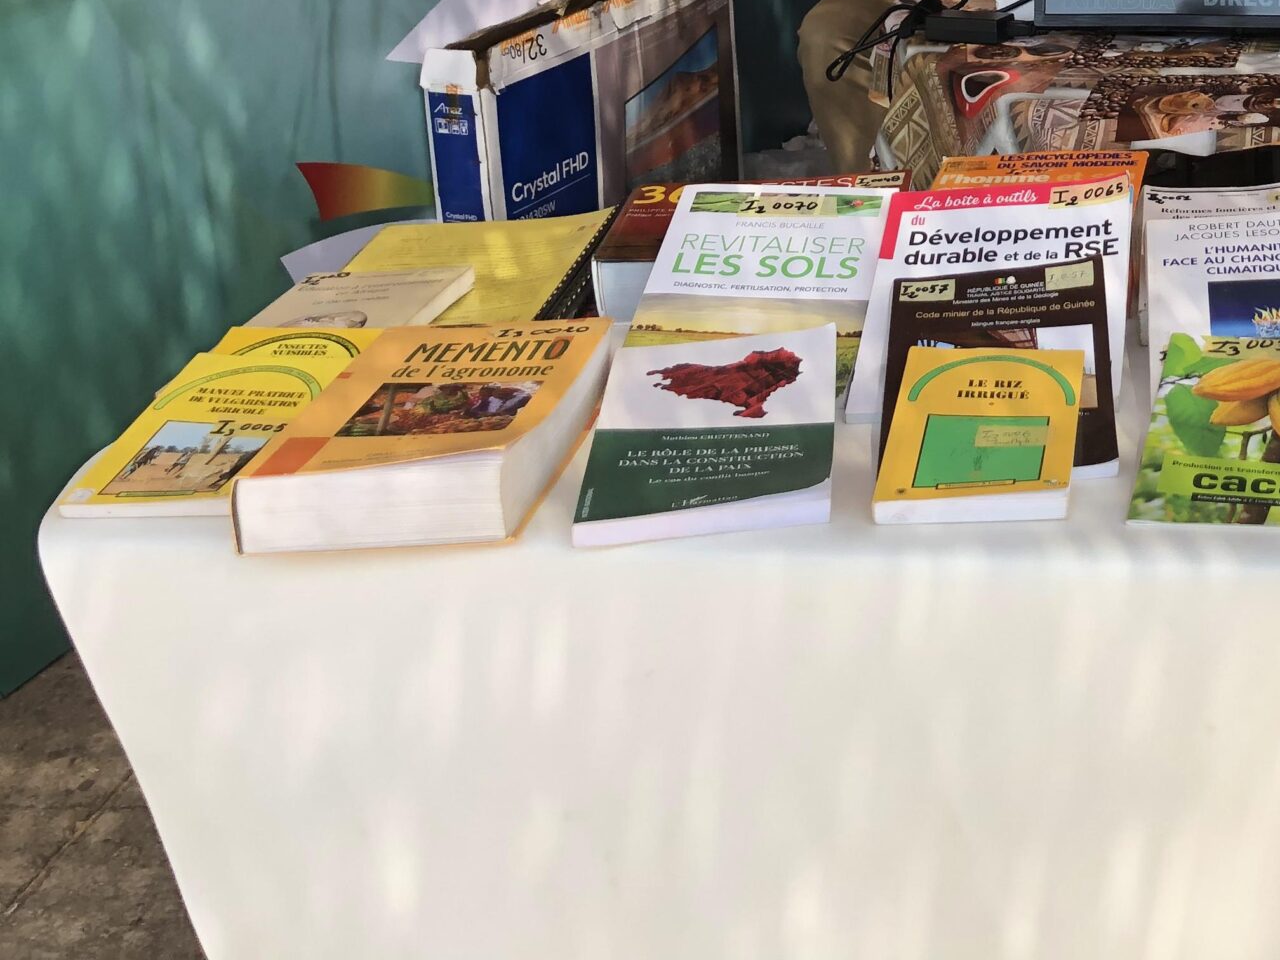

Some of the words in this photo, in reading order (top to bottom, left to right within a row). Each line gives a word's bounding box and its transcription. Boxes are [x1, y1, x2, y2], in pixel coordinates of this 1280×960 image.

[1000, 154, 1026, 162] LES
[1020, 161, 1068, 169] SAVOIR
[1072, 159, 1139, 167] MODERNE
[512, 163, 560, 202] Crystal
[562, 151, 589, 179] FHD
[914, 196, 942, 210] La
[945, 193, 980, 207] boîte
[984, 193, 993, 204] à
[996, 188, 1039, 204] outils
[735, 221, 777, 229] FRANCIS
[779, 221, 826, 230] BUCAILLE
[910, 213, 926, 226] du
[1188, 221, 1240, 231] ROBERT
[908, 219, 1113, 248] Développement
[1175, 230, 1240, 241] JACQUES
[680, 233, 866, 255] REVITALISER
[904, 245, 998, 266] durable
[1004, 251, 1019, 262] et
[1024, 249, 1041, 261] de
[1045, 249, 1058, 260] la
[1064, 238, 1119, 259] RSE
[671, 252, 742, 277] LES
[755, 254, 861, 280] SOLS
[1163, 257, 1198, 267] FACE
[1204, 256, 1225, 265] AU
[794, 285, 848, 293] PROTECTION
[915, 310, 940, 319] Code
[942, 309, 970, 318] minier
[973, 308, 985, 316] de
[997, 304, 1047, 316] République
[1049, 303, 1061, 311] de
[1063, 300, 1096, 310] Guinée
[404, 338, 572, 363] MEMENTO
[391, 364, 420, 378] de
[426, 364, 555, 381] l'agronome
[968, 378, 988, 388] LE
[994, 379, 1023, 389] RIZ
[198, 387, 244, 396] MANUEL
[248, 389, 307, 399] PRATIQUE
[957, 389, 1030, 400] IRRIGUÉ
[208, 397, 300, 407] VULGARISATION
[208, 406, 266, 415] AGRICOLE
[627, 450, 647, 458] LE
[651, 447, 692, 458] RÔLE
[696, 448, 717, 456] DE
[721, 447, 739, 455] LA
[744, 444, 799, 454] PRESSE
[618, 458, 659, 467] DANS
[663, 458, 681, 466] LA
[686, 451, 805, 465] CONSTRUCTION
[1172, 459, 1222, 471] Production
[669, 466, 691, 474] DE
[719, 463, 752, 471] PAIX
